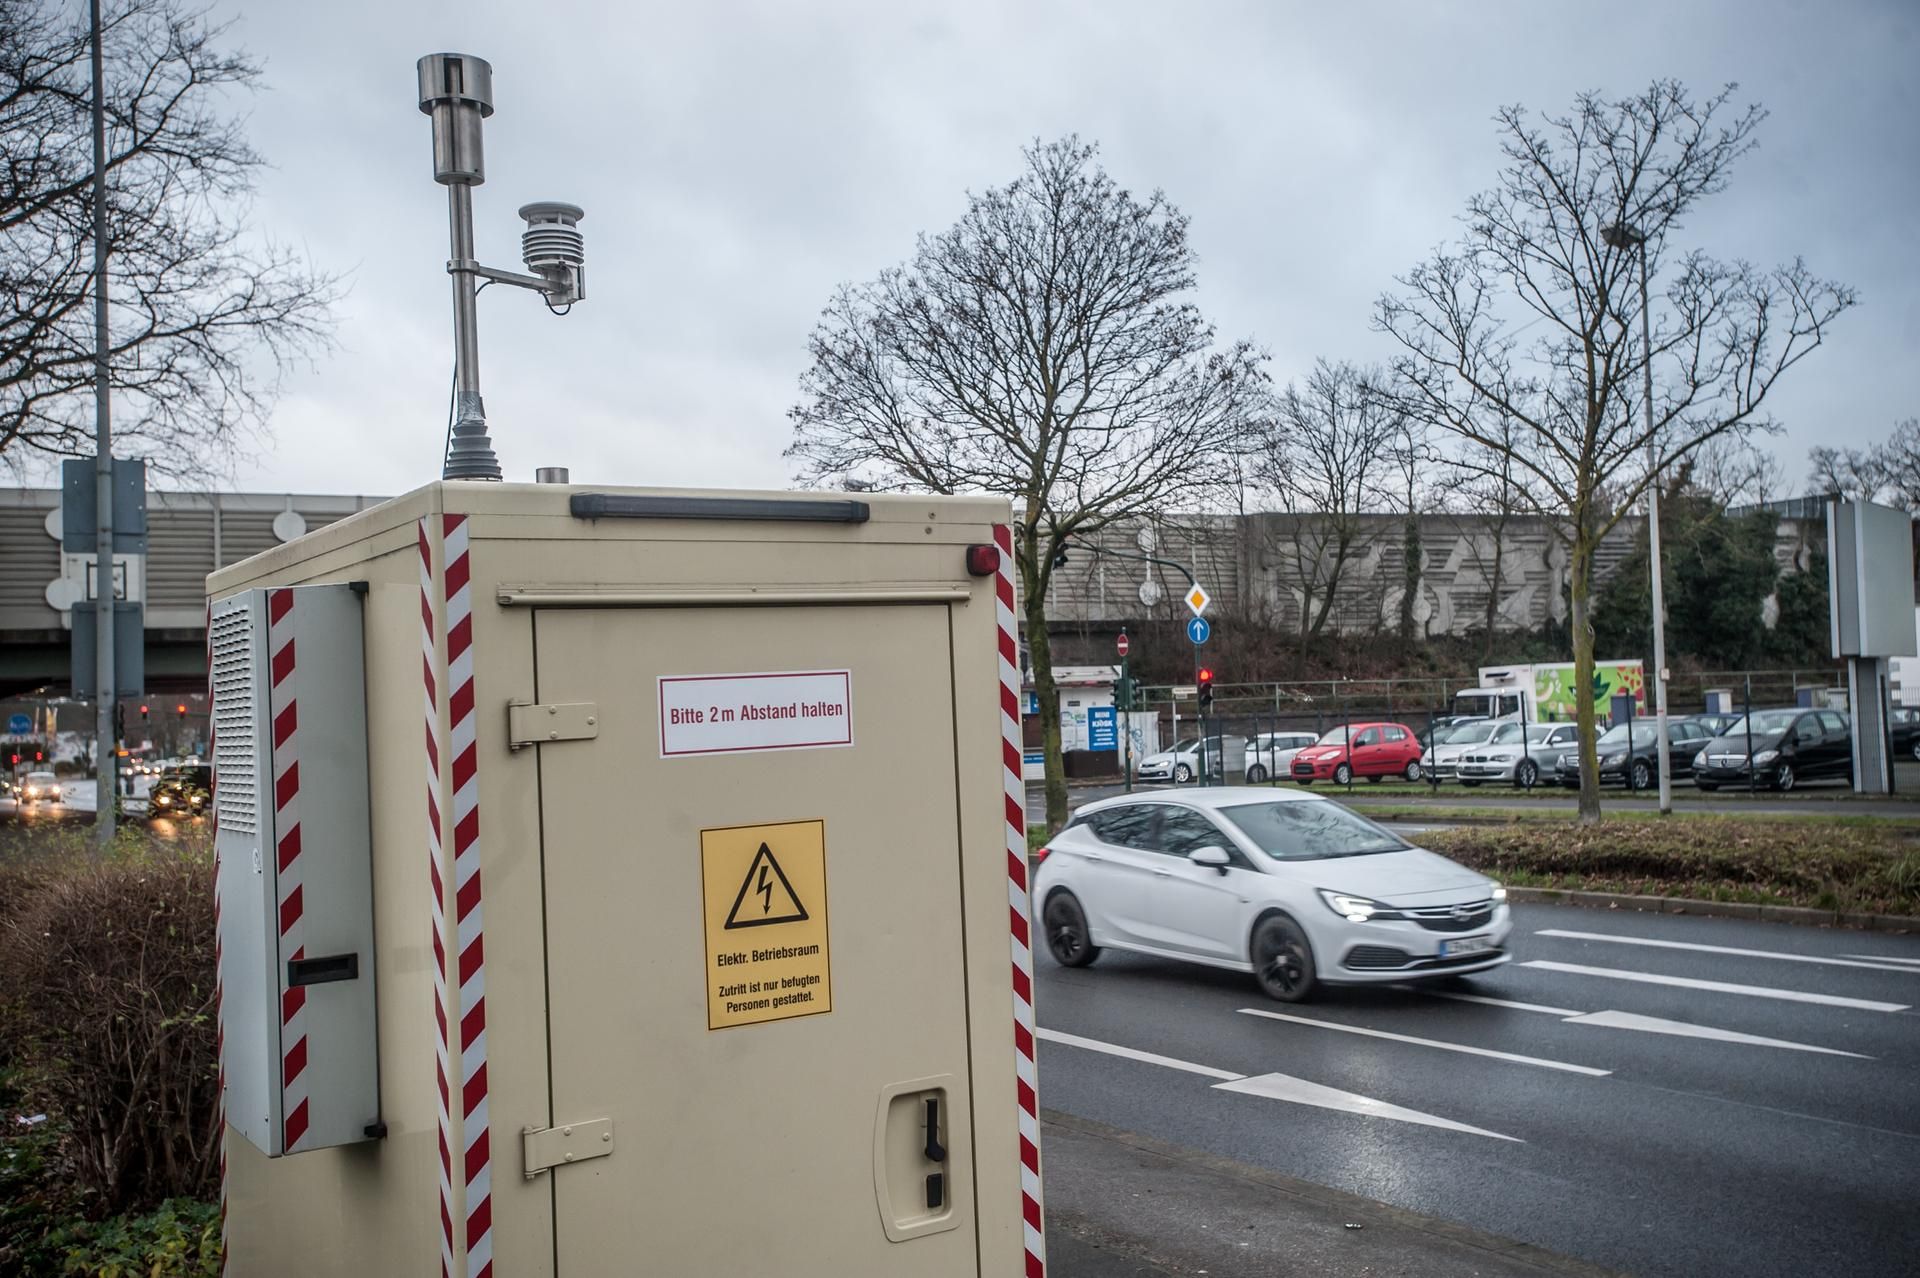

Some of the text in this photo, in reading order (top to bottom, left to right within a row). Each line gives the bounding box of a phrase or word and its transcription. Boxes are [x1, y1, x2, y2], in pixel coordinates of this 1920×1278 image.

[670, 708, 704, 725] Bitte
[740, 702, 797, 721] Abstand
[801, 701, 843, 718] halten
[717, 944, 819, 967] Elektr. Betriebsraum
[719, 974, 820, 997] Zutritt ist nur befugten
[727, 991, 814, 1013] Personen gestattet.
